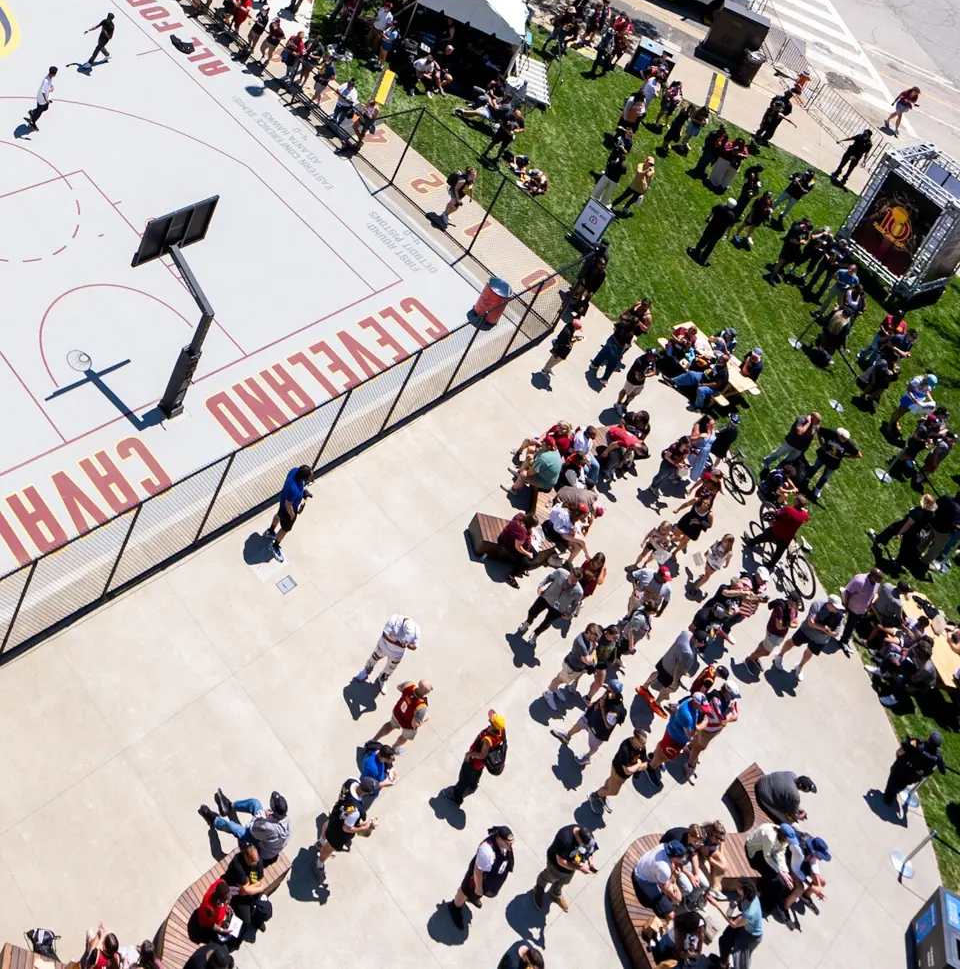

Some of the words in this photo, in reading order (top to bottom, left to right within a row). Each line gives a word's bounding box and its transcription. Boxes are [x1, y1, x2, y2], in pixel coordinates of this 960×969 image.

[254, 116, 301, 158] CONFERENCE
[262, 112, 290, 135] HAWKS
[287, 135, 321, 164] ATLANTA
[298, 158, 334, 190] EASTERN
[409, 171, 447, 195] 2
[368, 211, 404, 242] PISTONS
[394, 249, 421, 273] FIRST
[402, 242, 437, 274] DETROIT
[204, 297, 451, 448] CLEVELAND
